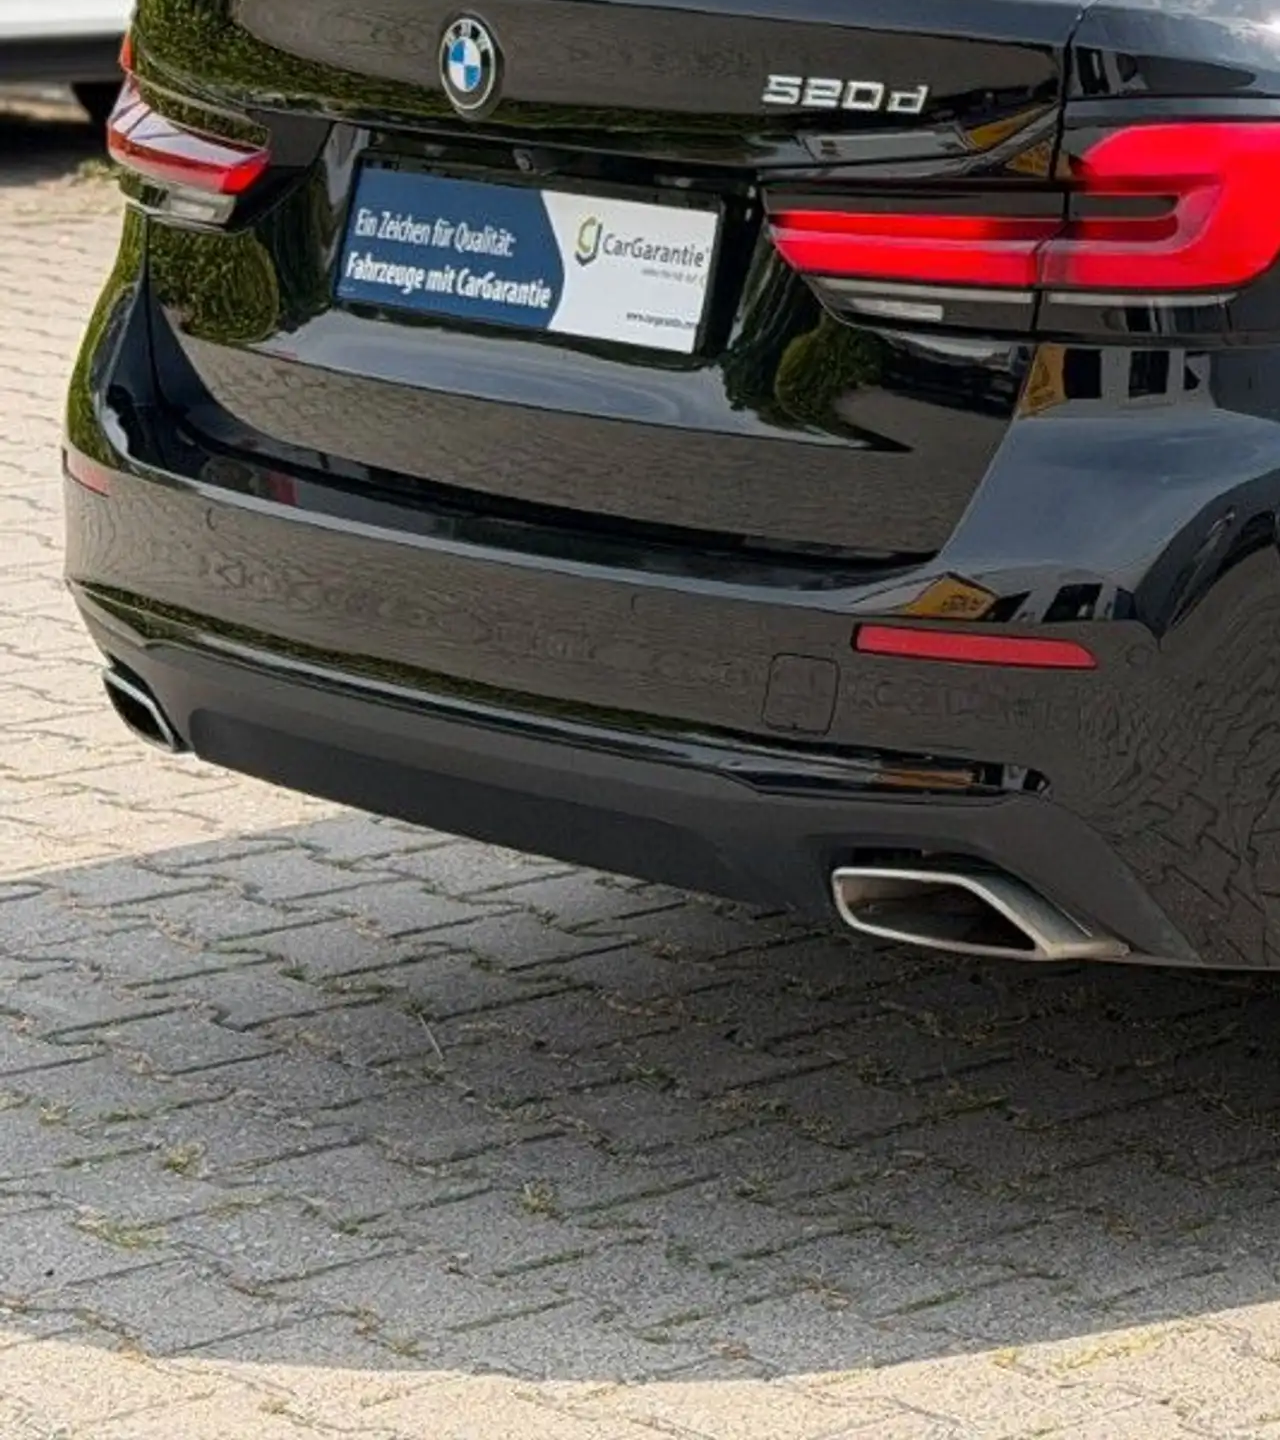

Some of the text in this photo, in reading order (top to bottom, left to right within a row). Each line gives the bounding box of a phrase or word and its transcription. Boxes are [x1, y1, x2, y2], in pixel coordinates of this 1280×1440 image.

[761, 74, 928, 114] 520d
[355, 208, 377, 237] Ein
[377, 211, 430, 246] Zeichen
[431, 218, 454, 248] für
[602, 233, 705, 268] CarGarantie
[345, 252, 551, 309] Fahrzeuge mit CarGarantie
